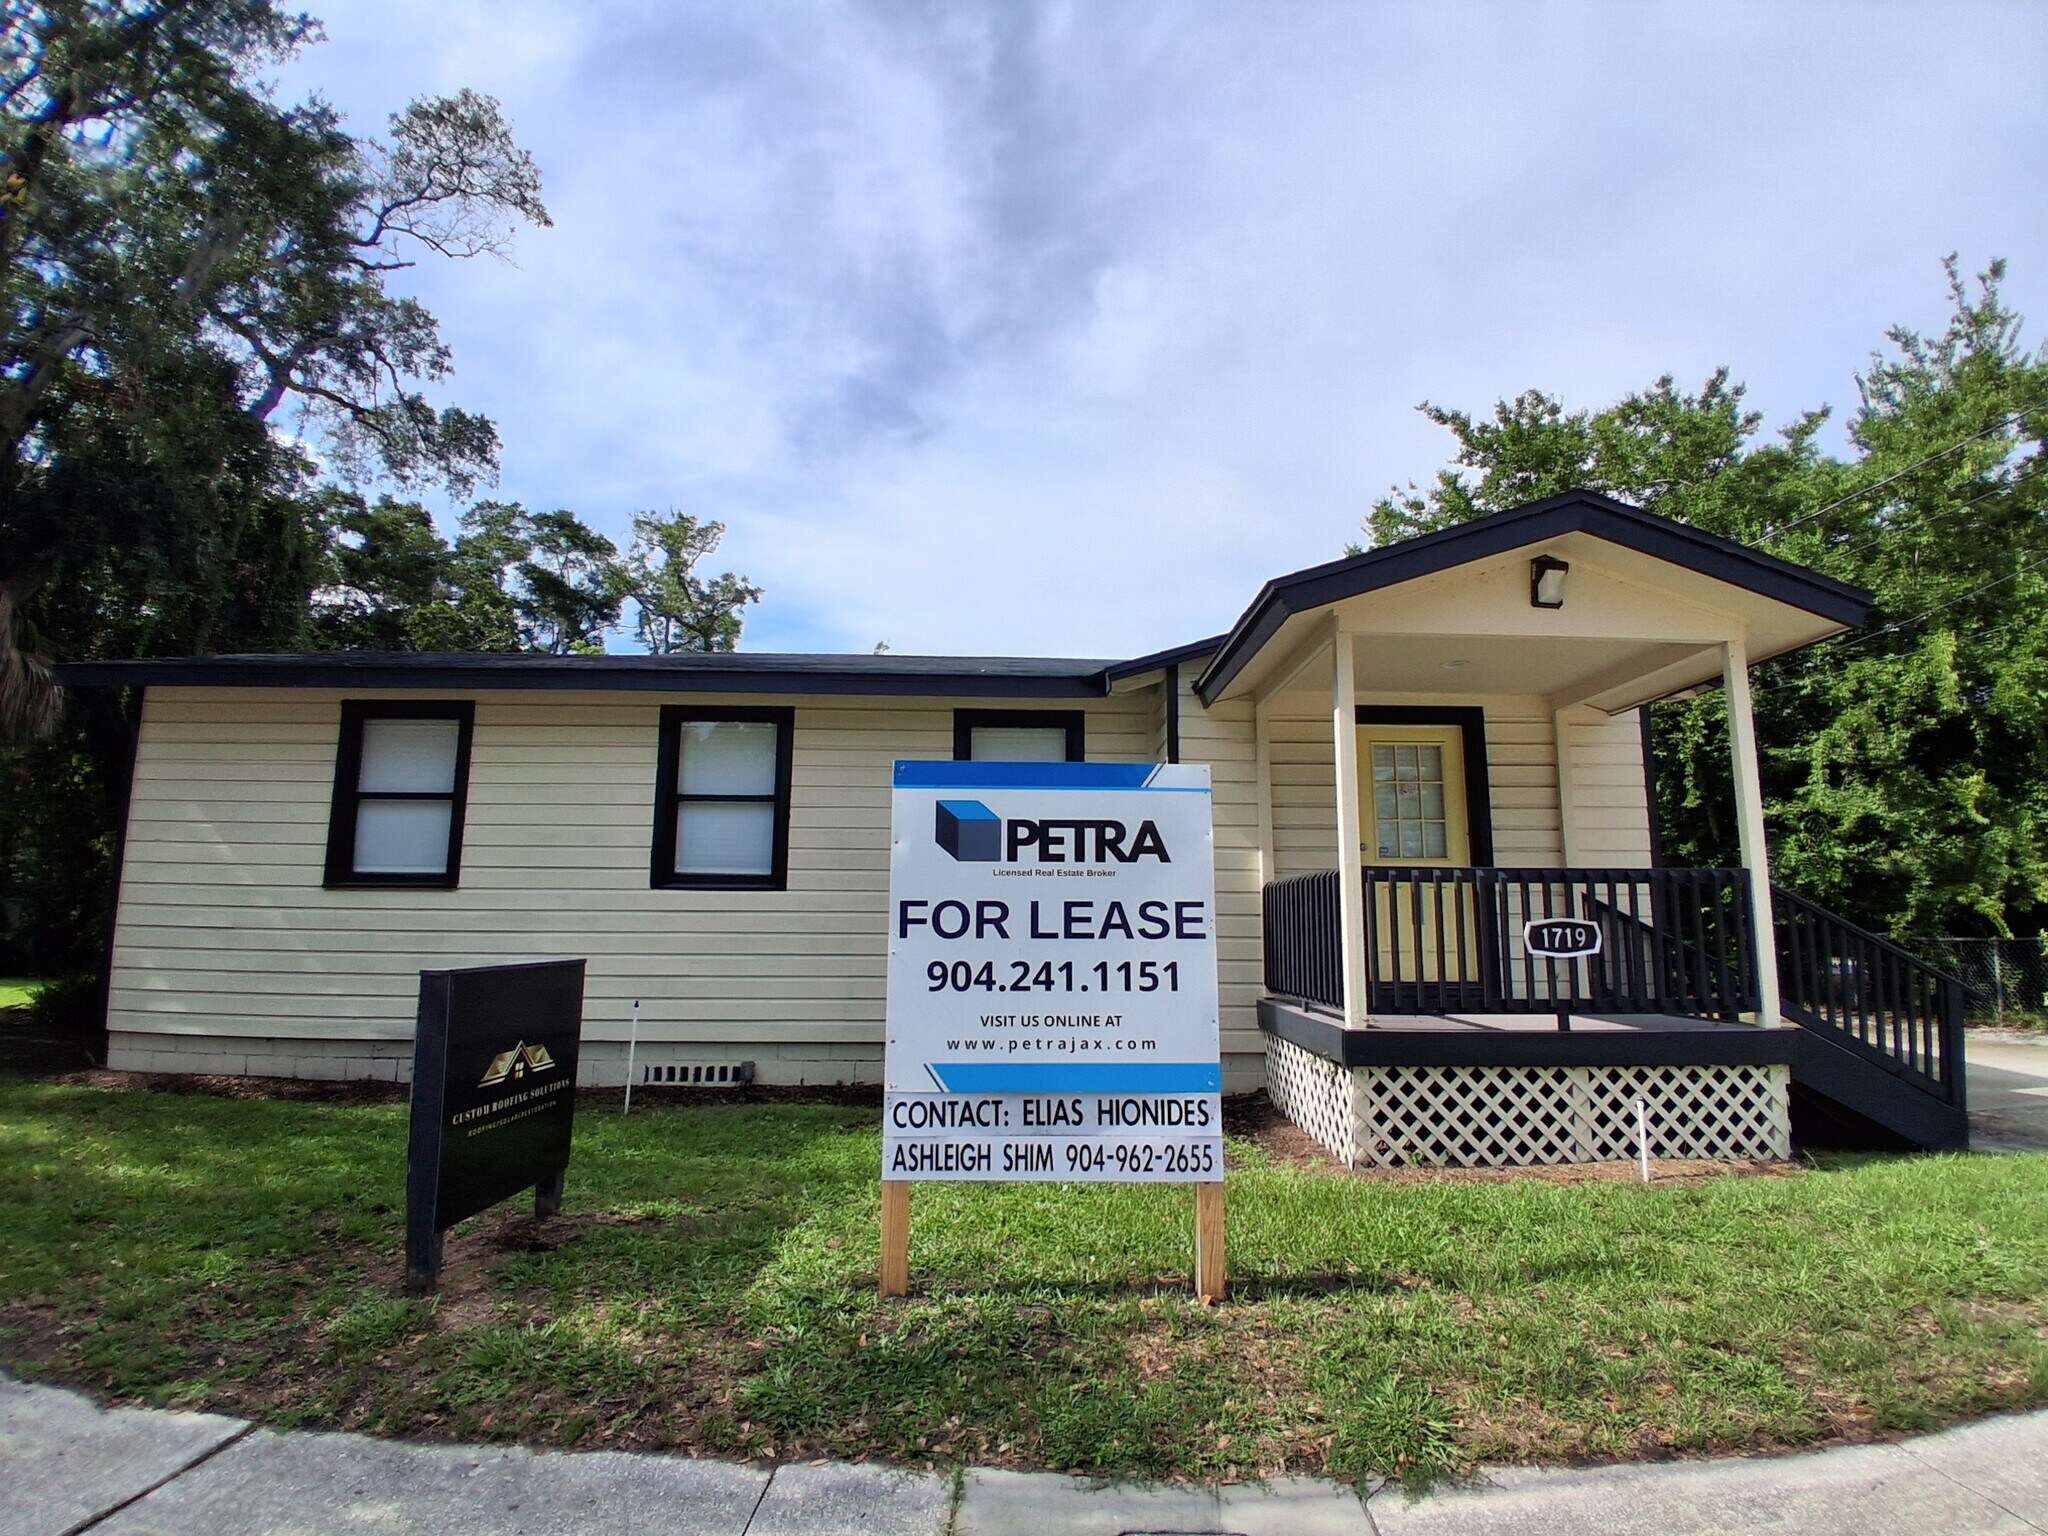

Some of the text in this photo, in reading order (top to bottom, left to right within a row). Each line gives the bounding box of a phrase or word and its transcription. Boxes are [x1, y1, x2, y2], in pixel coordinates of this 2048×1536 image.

[1006, 819, 1172, 863] PETRA
[992, 869, 1116, 877] Licensed Real Estate Broker
[899, 900, 1206, 940] FOR LEASE
[1542, 927, 1586, 948] 1719
[927, 961, 1179, 993] 904.241.1151
[980, 1015, 1122, 1027] VISIT US ONLINE AT
[947, 1037, 1156, 1053] www.petrajax.com
[452, 1078, 570, 1125] CUSTOM ROOFING SOLUTIONS
[893, 1099, 1210, 1128] CONTACT: ELIAS HIONIDES
[892, 1144, 1212, 1173] ASHLEIGH SHIM 904-962-2655
